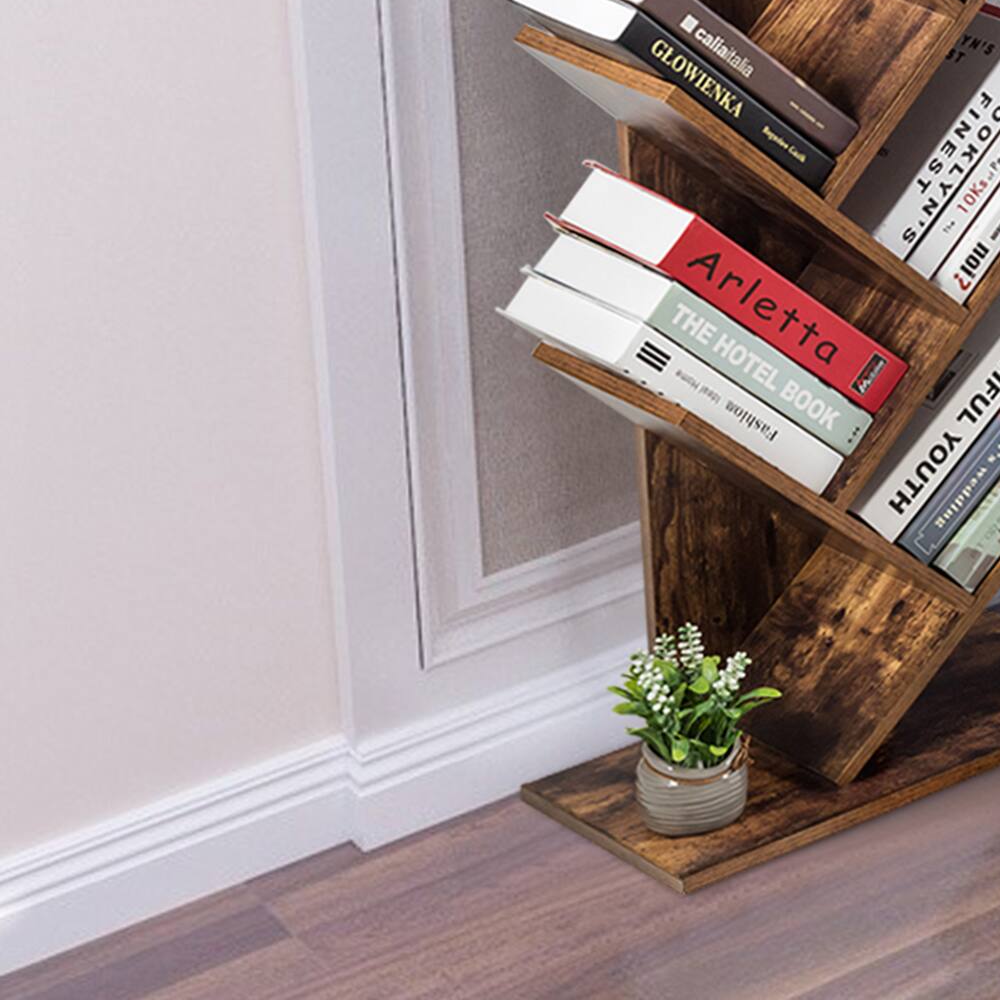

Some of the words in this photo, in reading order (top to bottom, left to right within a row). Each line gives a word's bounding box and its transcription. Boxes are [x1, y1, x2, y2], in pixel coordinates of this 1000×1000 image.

[694, 27, 754, 79] caliaitalia
[917, 91, 993, 194] FINEST
[956, 180, 988, 214] 10Ks
[953, 241, 990, 292] noi?
[687, 251, 839, 365] Arletta
[671, 303, 717, 345] THE
[712, 331, 779, 391] HOTEL
[780, 376, 841, 431] BOOK
[725, 401, 779, 443] Fashion
[888, 431, 962, 516] YOUTH
[935, 467, 987, 529] wedding
